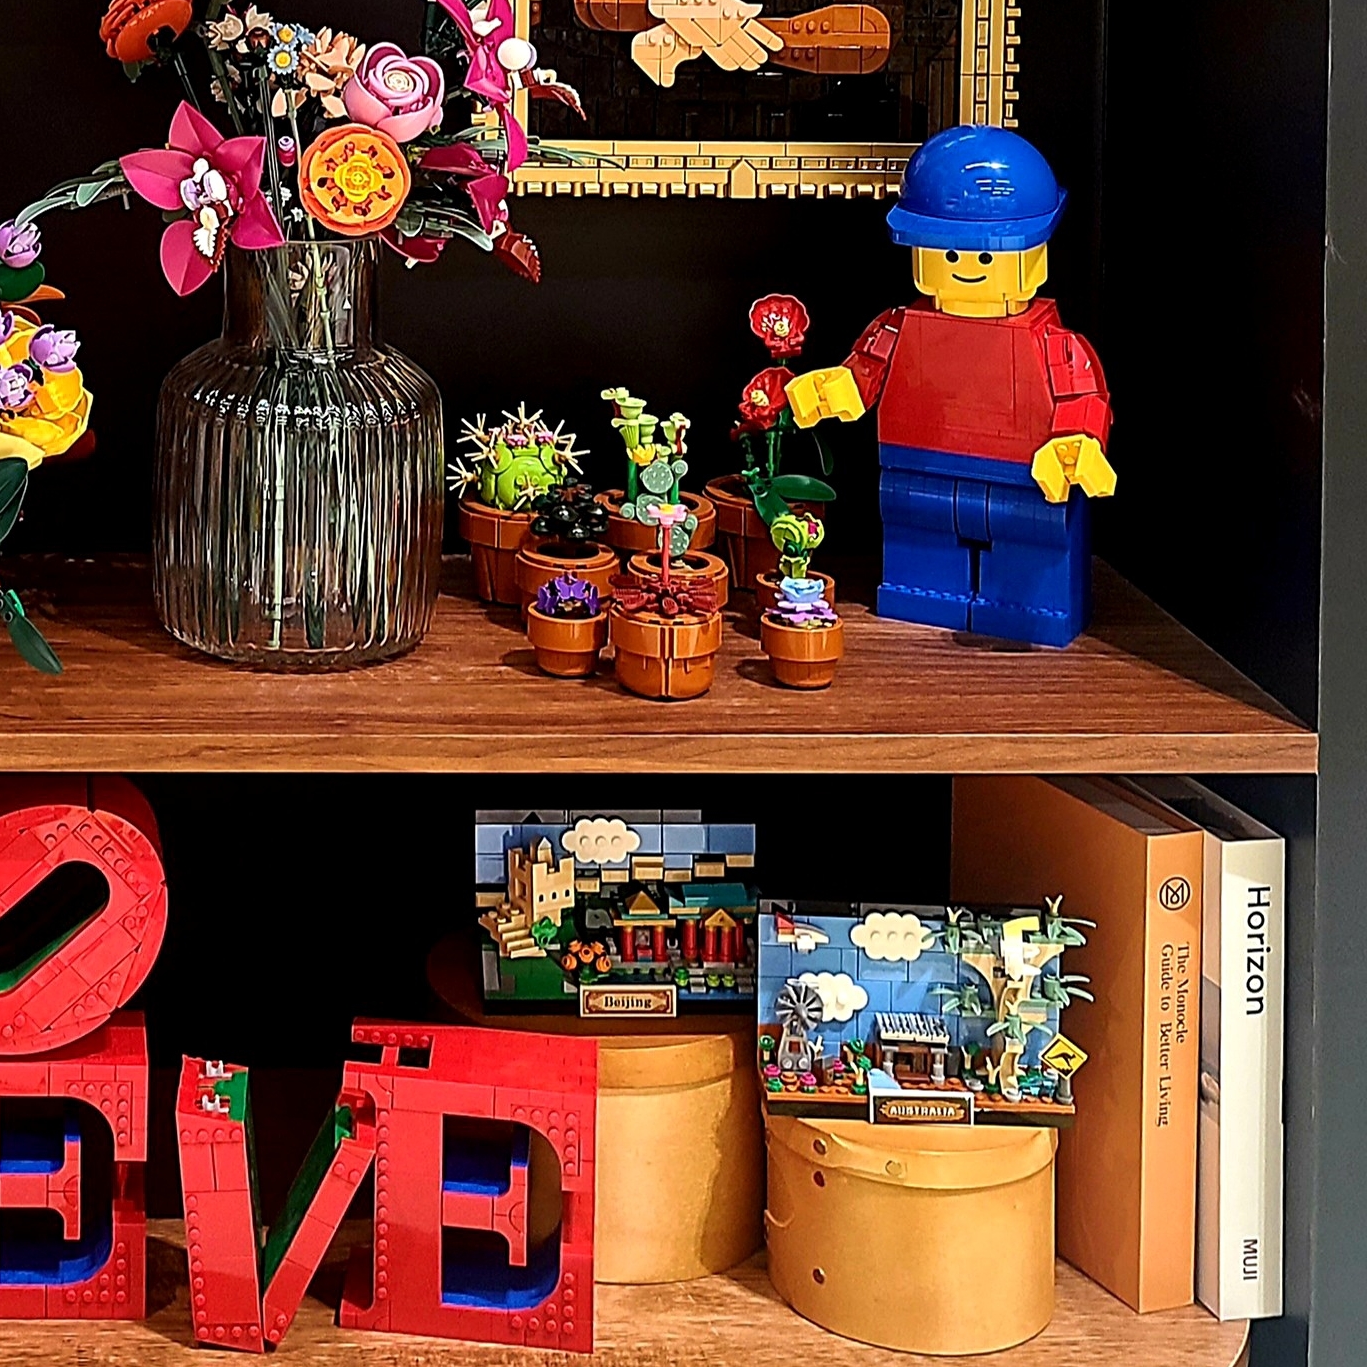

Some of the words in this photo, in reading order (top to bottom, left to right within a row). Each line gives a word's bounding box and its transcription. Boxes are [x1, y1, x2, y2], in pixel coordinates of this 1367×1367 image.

[1161, 944, 1173, 990] Guide
[1177, 941, 1189, 974] The
[1246, 887, 1271, 1015] Horizon
[605, 996, 652, 1009] Beijing
[1161, 996, 1171, 1011] to
[1176, 980, 1188, 1043] Monocle
[1160, 1023, 1172, 1070] Better
[890, 1106, 954, 1116] AUSTRALIA
[1156, 1077, 1171, 1127] Living
[1243, 1239, 1257, 1280] MUJI
